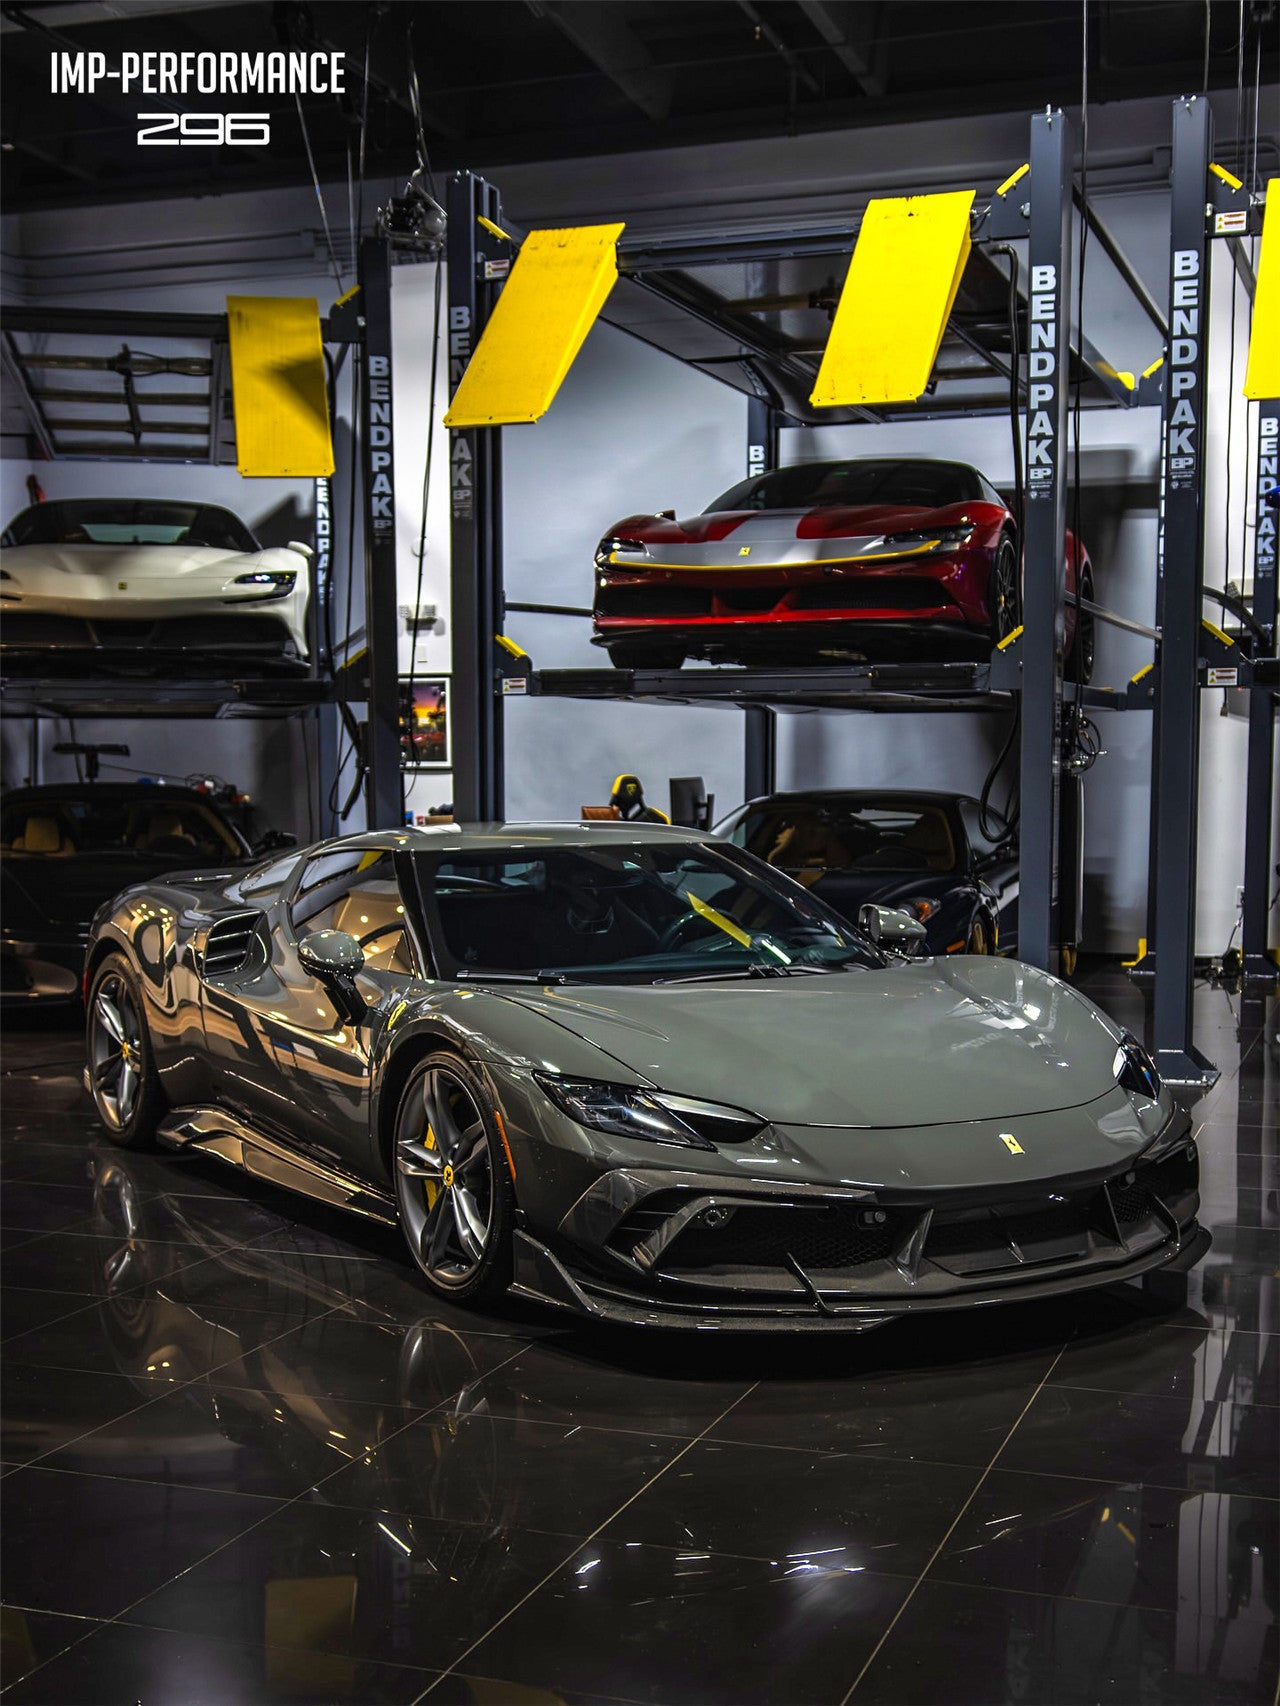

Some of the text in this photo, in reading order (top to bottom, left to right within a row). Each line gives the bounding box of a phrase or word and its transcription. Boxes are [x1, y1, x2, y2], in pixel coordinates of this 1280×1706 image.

[368, 355, 393, 518] BENDPAK
[450, 306, 473, 487] BENAK
[1028, 264, 1057, 465] BENDPAK
[1170, 250, 1199, 454] BENDPAK
